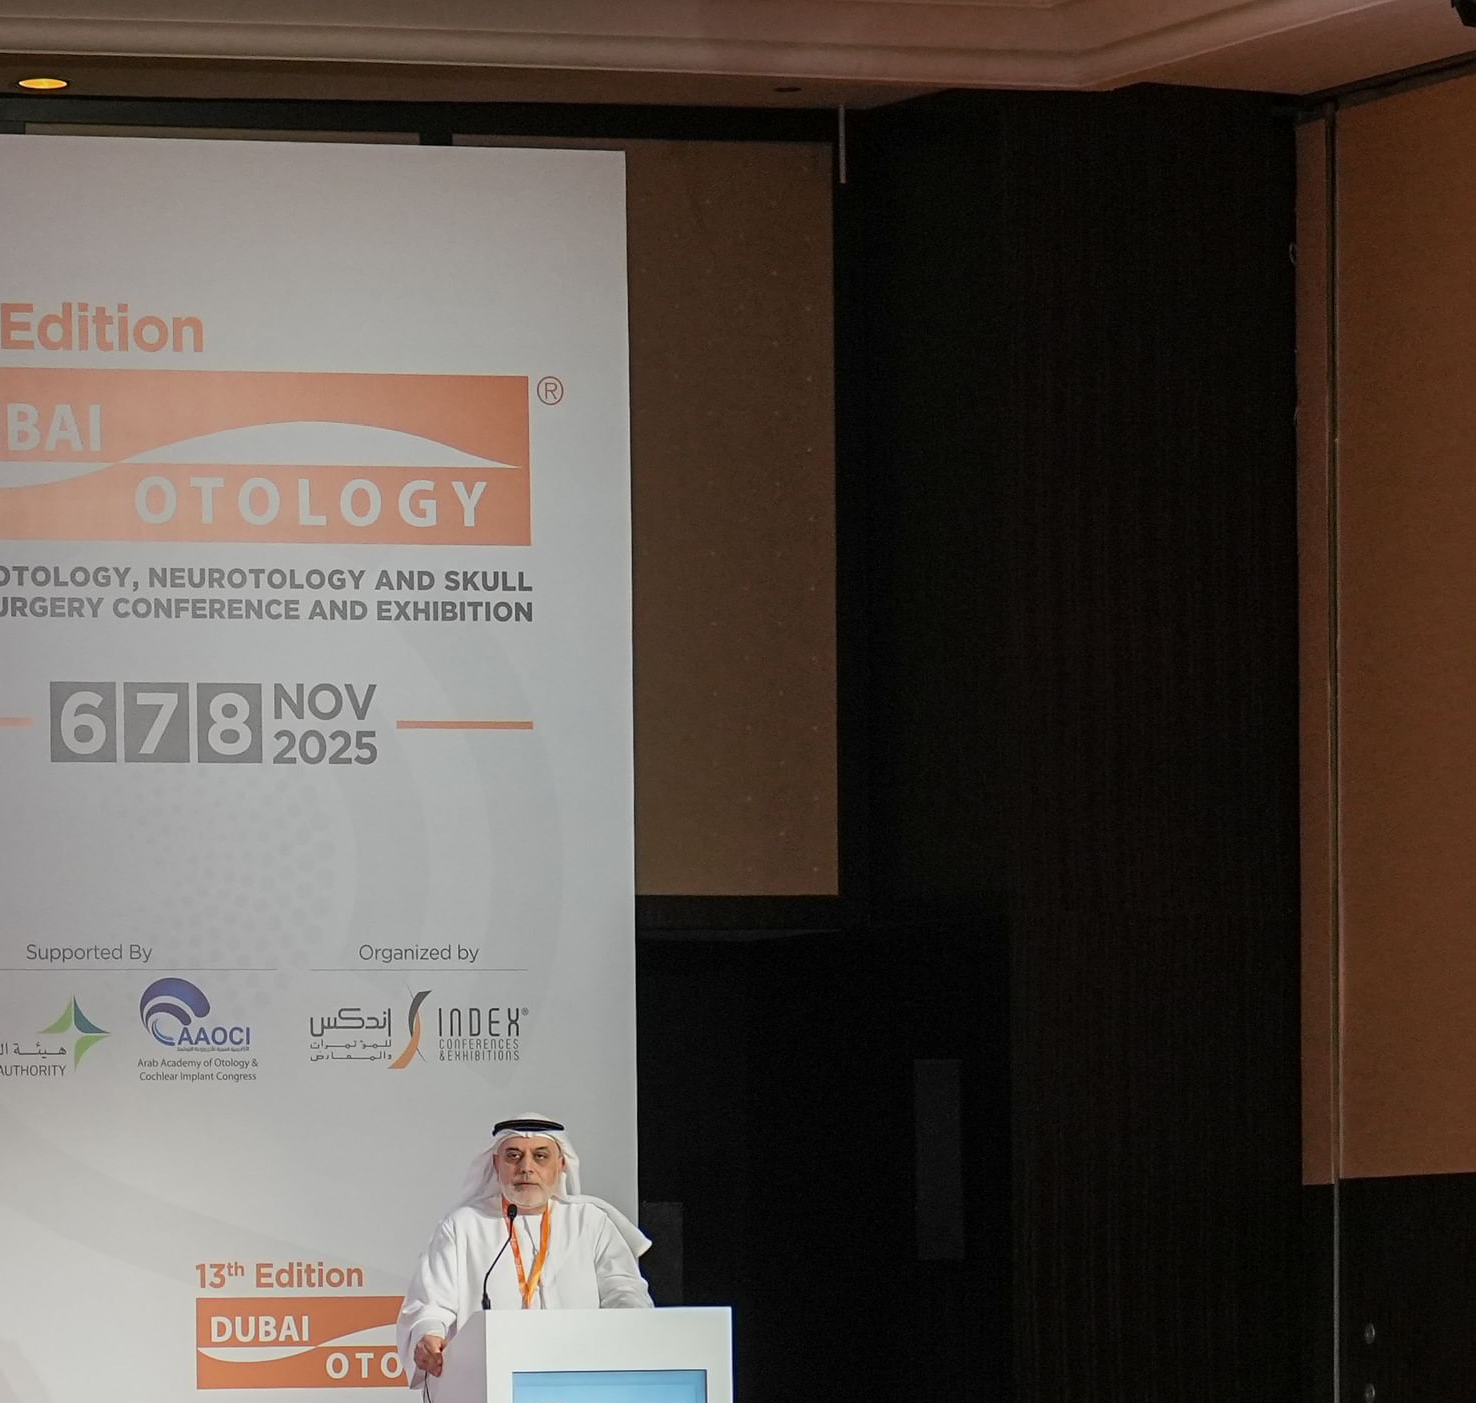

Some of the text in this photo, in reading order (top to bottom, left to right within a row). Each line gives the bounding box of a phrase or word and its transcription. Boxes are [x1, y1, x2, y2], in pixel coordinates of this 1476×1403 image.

[0, 303, 204, 353] Edition
[135, 476, 487, 528] OTOLOGY
[149, 567, 364, 591] NEUROTOLOGY
[375, 570, 434, 591] AND
[445, 570, 532, 592] SKULL
[113, 598, 300, 620] CONFERENCE
[309, 600, 368, 621] AND
[377, 601, 533, 623] EXHIBITION
[274, 684, 377, 721] NOV
[274, 731, 377, 765] 2025
[26, 944, 152, 962] Supported By
[359, 944, 479, 963] Organized by
[178, 1027, 250, 1046] AAOCI
[439, 1039, 519, 1049] CONFERENCES
[138, 1059, 258, 1069] Arab Academy of Otology &
[140, 1072, 256, 1083] Cochlear Implant Congress
[196, 1261, 363, 1289] 13th Edition
[211, 1315, 309, 1342] DUBAI
